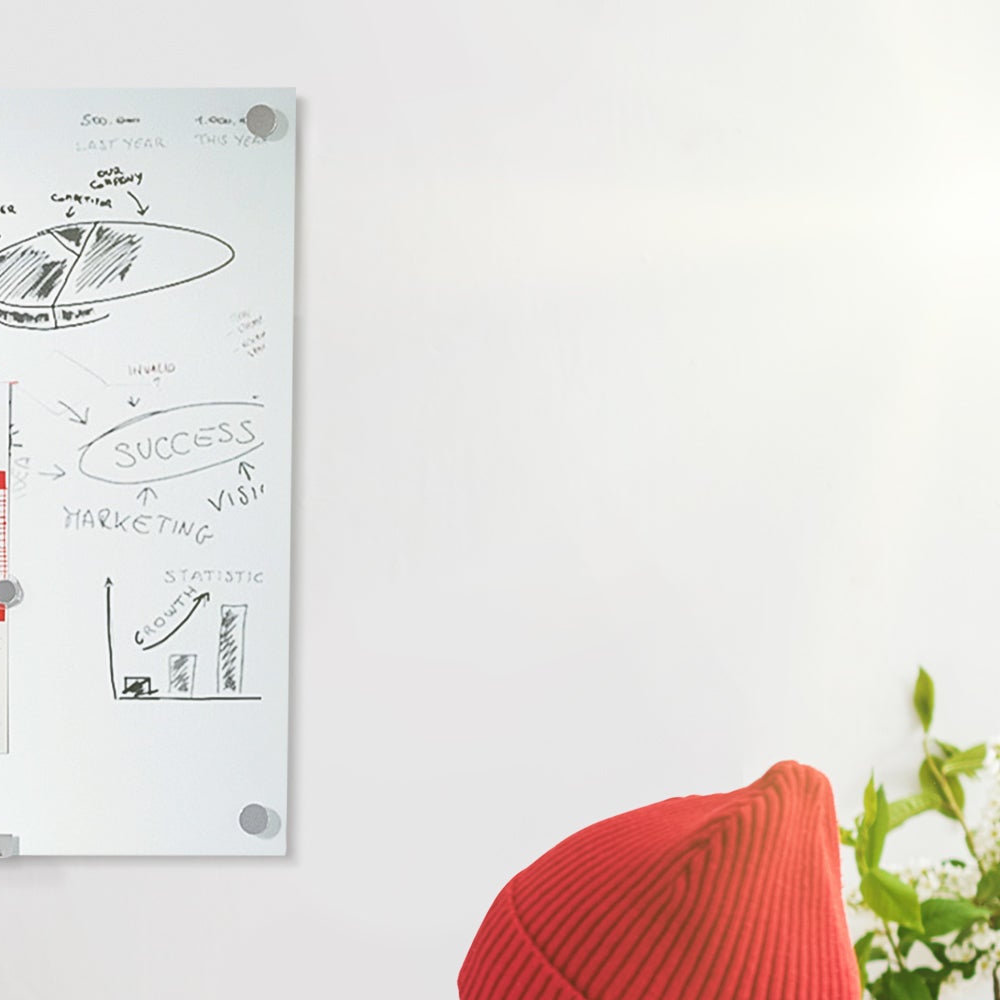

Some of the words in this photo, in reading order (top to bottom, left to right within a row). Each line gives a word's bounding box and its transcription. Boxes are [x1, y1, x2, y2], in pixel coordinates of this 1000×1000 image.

[76, 137, 119, 152] LAST
[122, 137, 169, 149] YEAR
[194, 134, 229, 146] THIS
[114, 420, 257, 468] SUCCESS
[62, 505, 214, 545] MARKETING
[164, 570, 264, 584] STATISTIC
[134, 585, 198, 646] GROWTH
